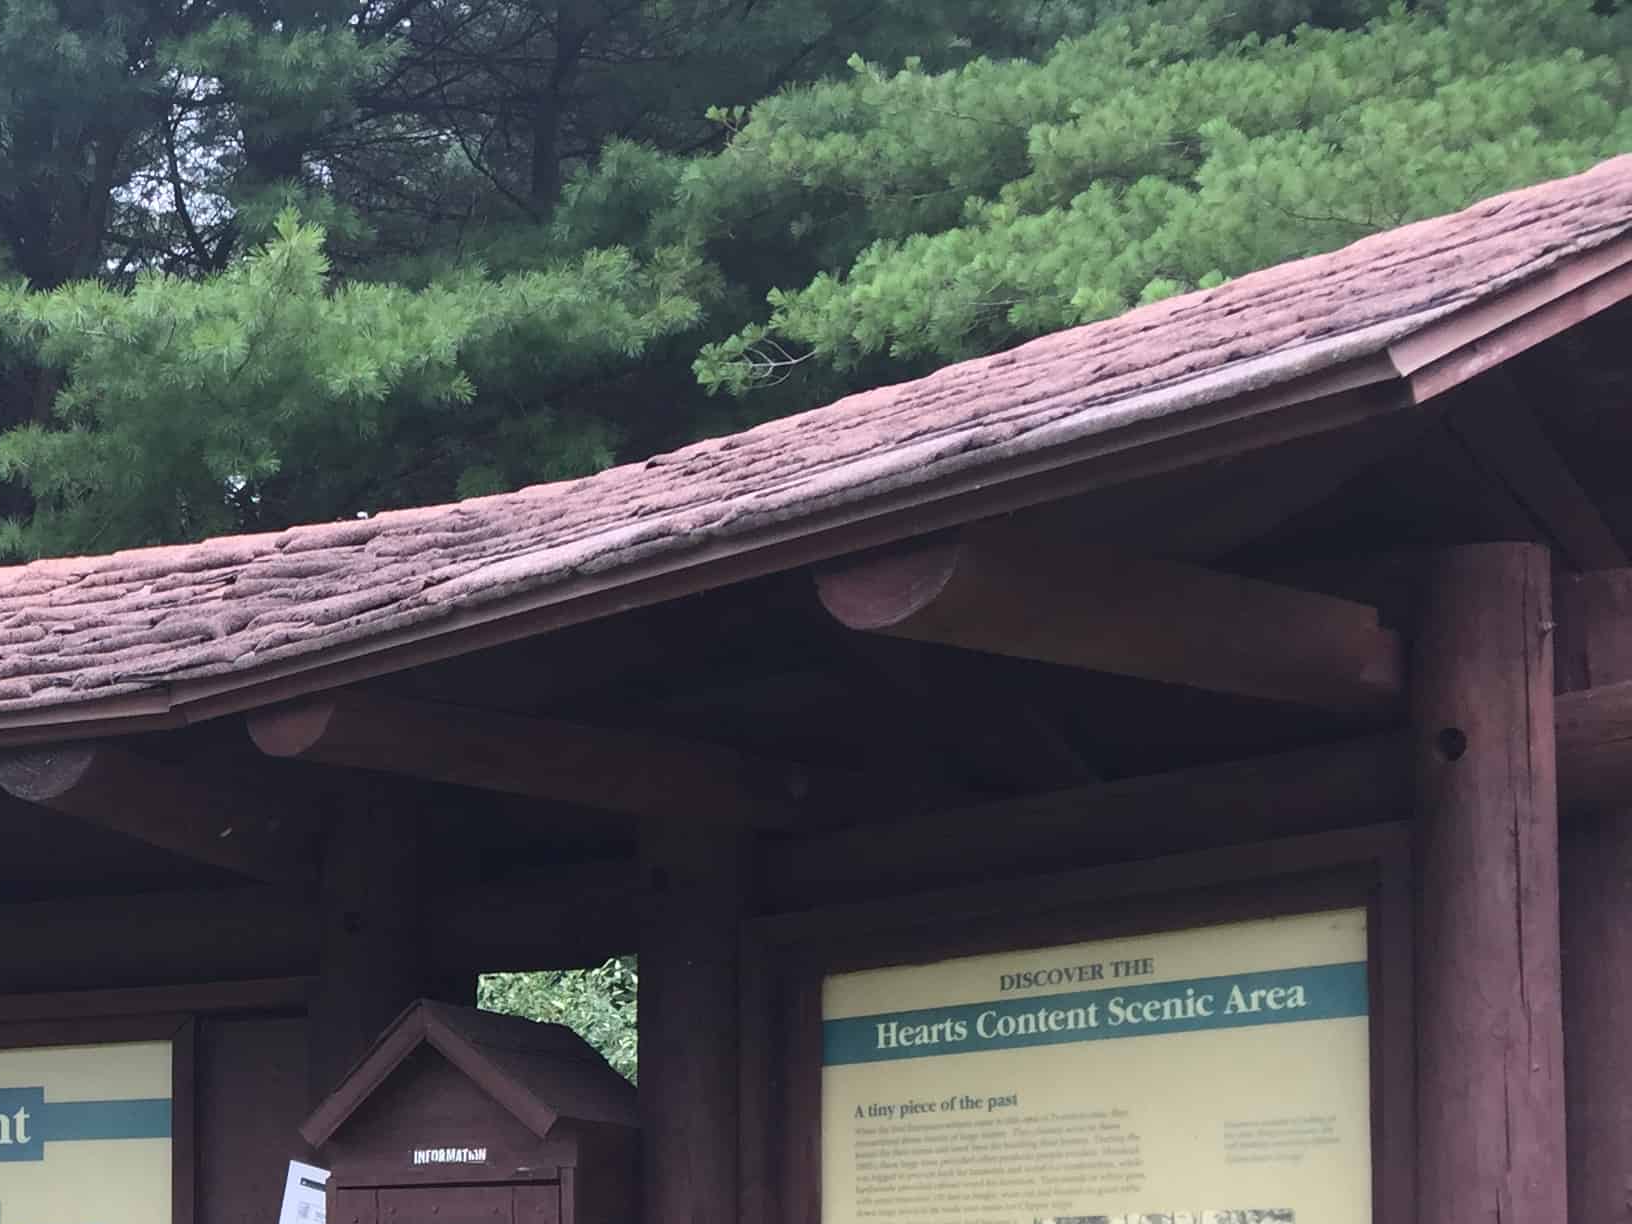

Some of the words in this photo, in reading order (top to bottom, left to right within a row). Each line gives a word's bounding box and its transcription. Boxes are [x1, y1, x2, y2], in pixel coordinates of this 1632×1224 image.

[1000, 962, 1103, 992] DISCOVER
[1110, 958, 1154, 978] THE
[876, 1017, 967, 1049] Hearts
[976, 998, 1098, 1039] Content
[1108, 988, 1214, 1025] Scenic
[1224, 983, 1307, 1014] Area
[855, 1106, 864, 1118] A
[868, 1103, 895, 1120] tiny
[900, 1100, 936, 1119] piece
[941, 1096, 956, 1112] of
[960, 1095, 982, 1110] the
[988, 1094, 1017, 1112] past
[414, 1147, 486, 1164] INFORMATION
